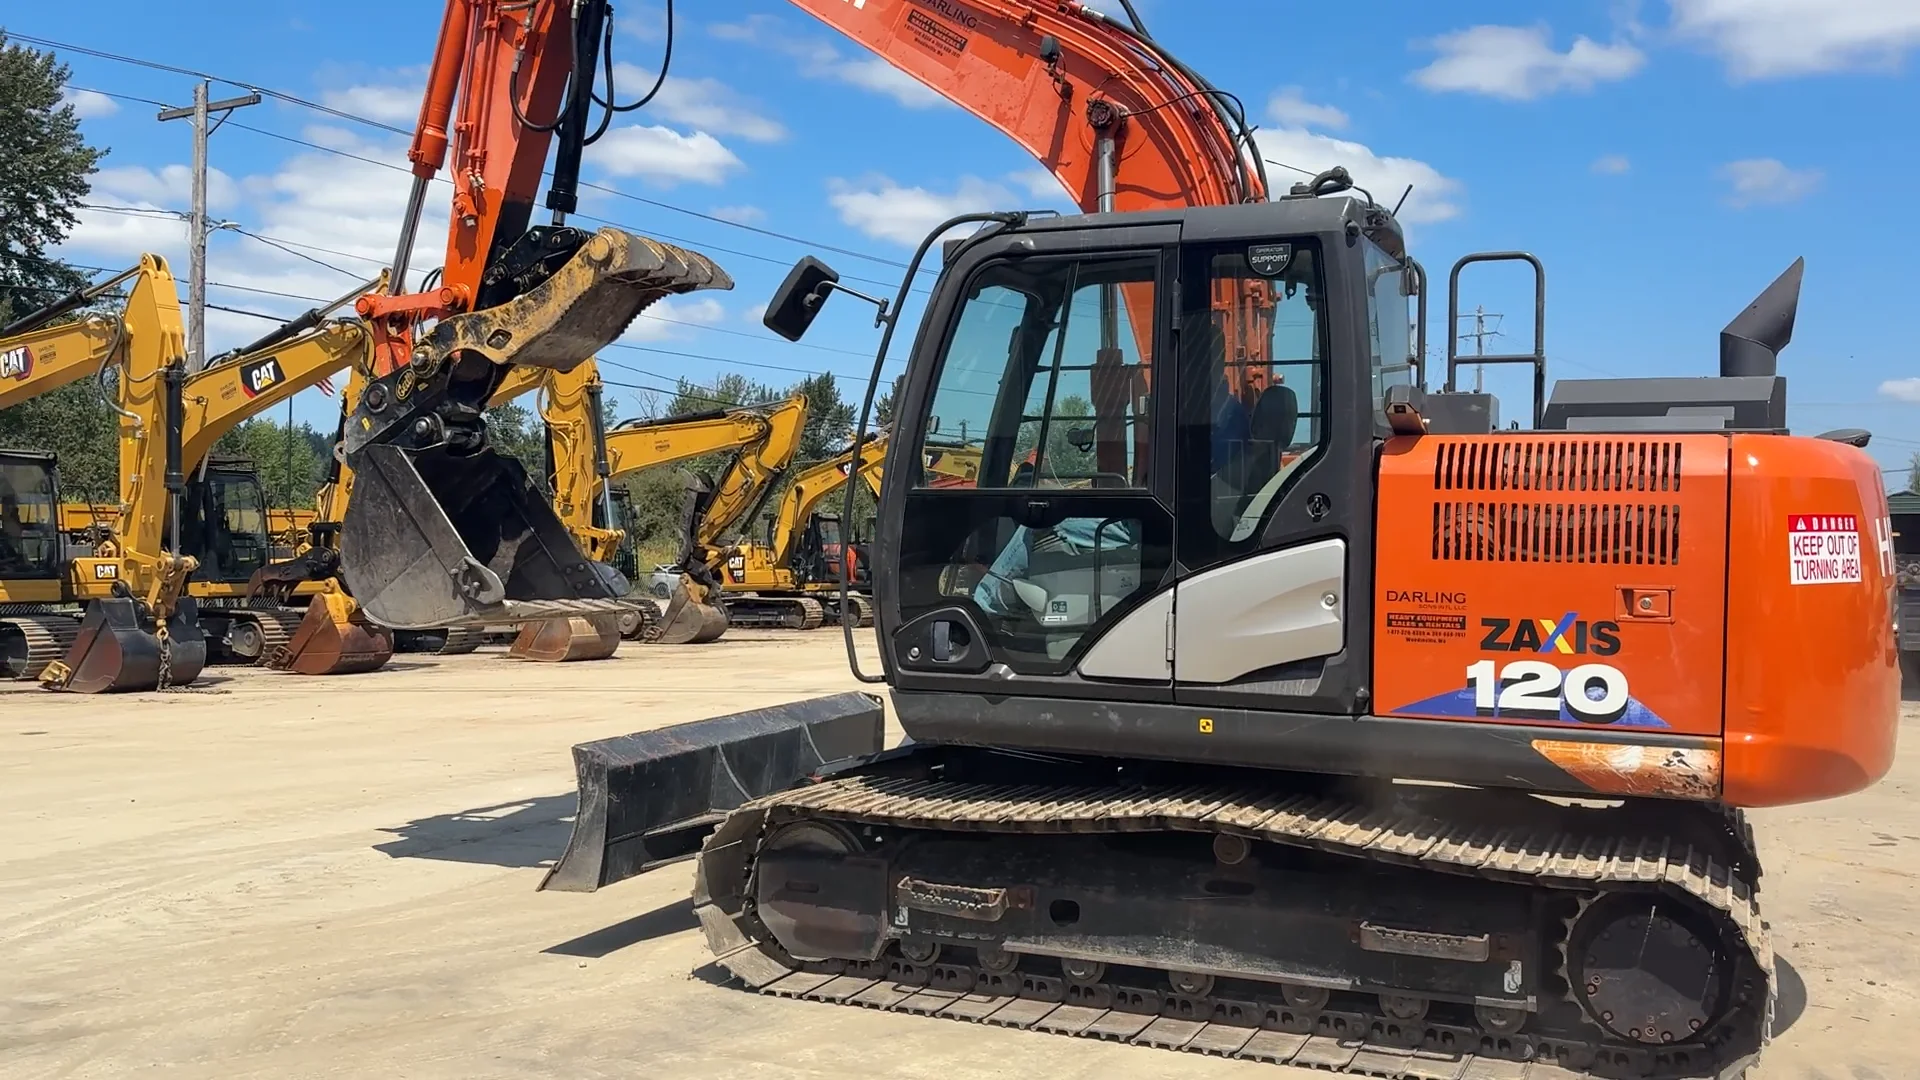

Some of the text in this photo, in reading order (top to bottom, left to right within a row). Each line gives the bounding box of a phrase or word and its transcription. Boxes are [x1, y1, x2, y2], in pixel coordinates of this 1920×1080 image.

[1252, 254, 1288, 263] SUPPORT
[1, 347, 24, 378] CAT
[251, 361, 275, 390] CAT
[1812, 517, 1854, 530] DANGER
[1793, 535, 1857, 556] KEEP OUT OF
[97, 565, 116, 579] CAT
[729, 556, 744, 569] CAT
[1794, 559, 1860, 580] TURNING AREA
[1386, 591, 1466, 604] DARLING
[1480, 611, 1621, 656] ZAXIS
[1466, 660, 1629, 722] 120
